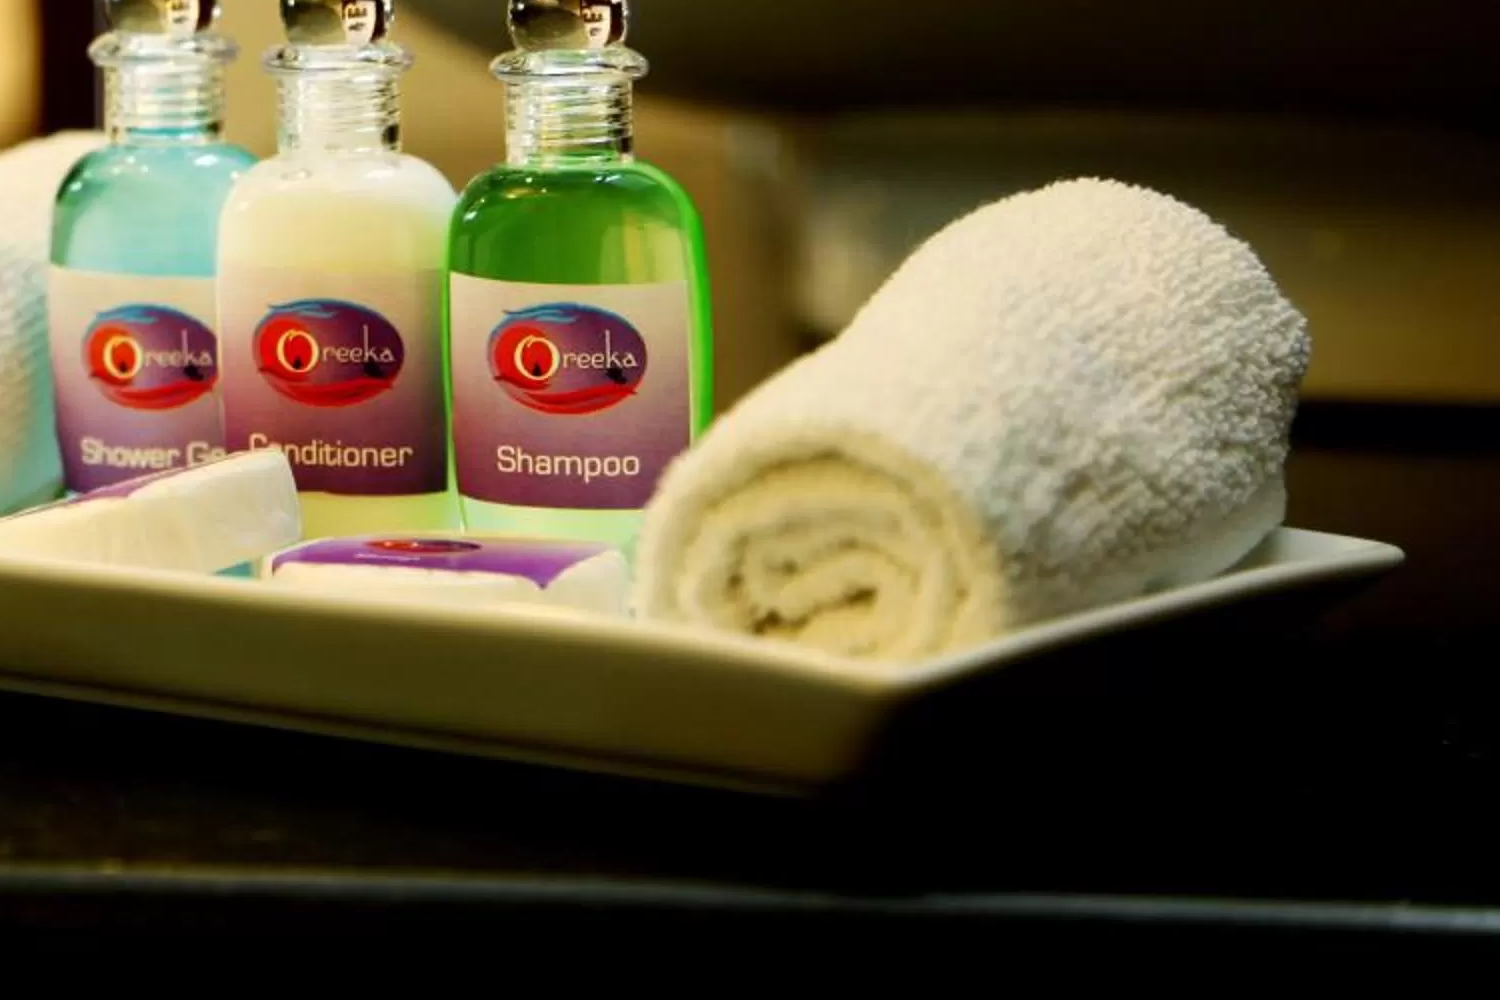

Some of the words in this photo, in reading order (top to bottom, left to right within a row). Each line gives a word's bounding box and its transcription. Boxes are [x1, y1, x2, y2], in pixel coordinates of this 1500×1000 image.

[103, 329, 213, 379] Oreeka
[277, 325, 395, 373] Oreeka
[514, 329, 638, 380] Oreeka
[81, 437, 179, 469] Shower
[249, 433, 413, 467] Cnditioner
[496, 445, 640, 483] Shampoo
